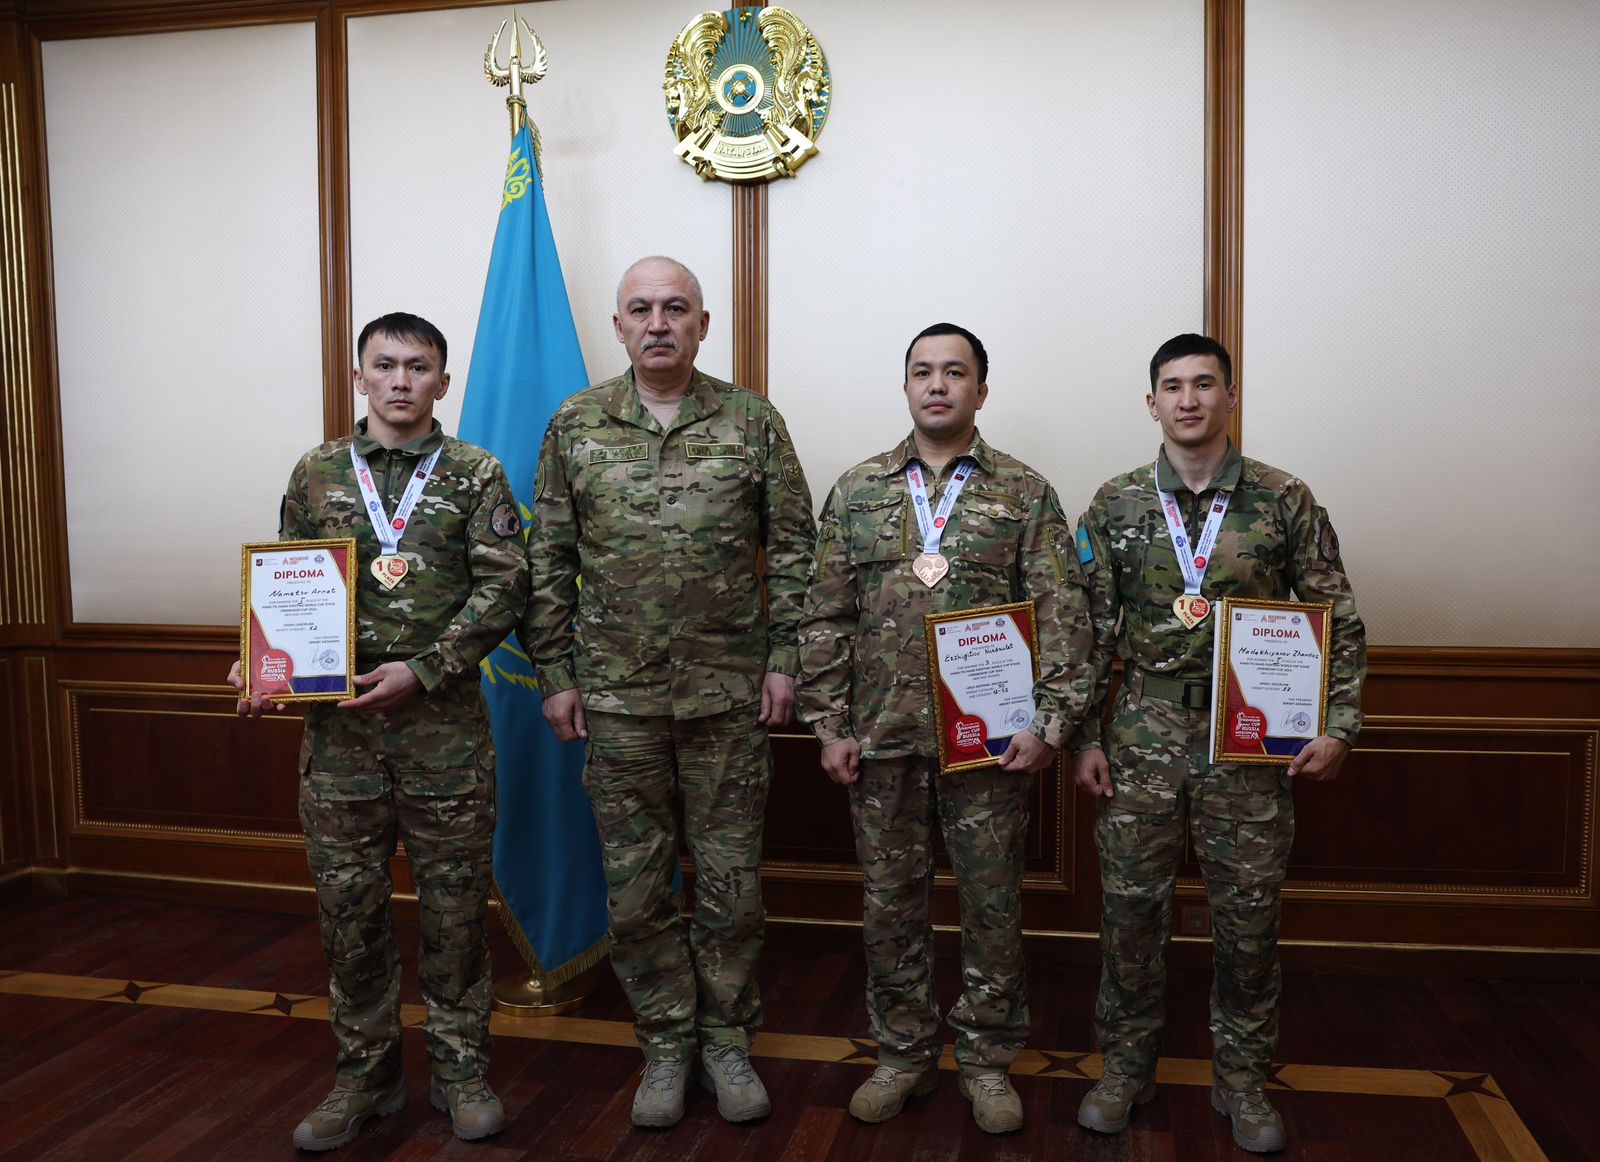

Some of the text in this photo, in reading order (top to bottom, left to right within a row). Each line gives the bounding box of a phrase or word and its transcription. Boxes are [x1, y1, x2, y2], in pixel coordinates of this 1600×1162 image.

[716, 142, 769, 157] QAZAQSTAN
[376, 561, 382, 572] 1
[274, 569, 324, 579] DIPLOMA
[1178, 599, 1185, 610] 1
[1182, 612, 1194, 624] PLACE
[1252, 628, 1300, 638] DIPLOMA
[958, 632, 1007, 647] DIPLOMA
